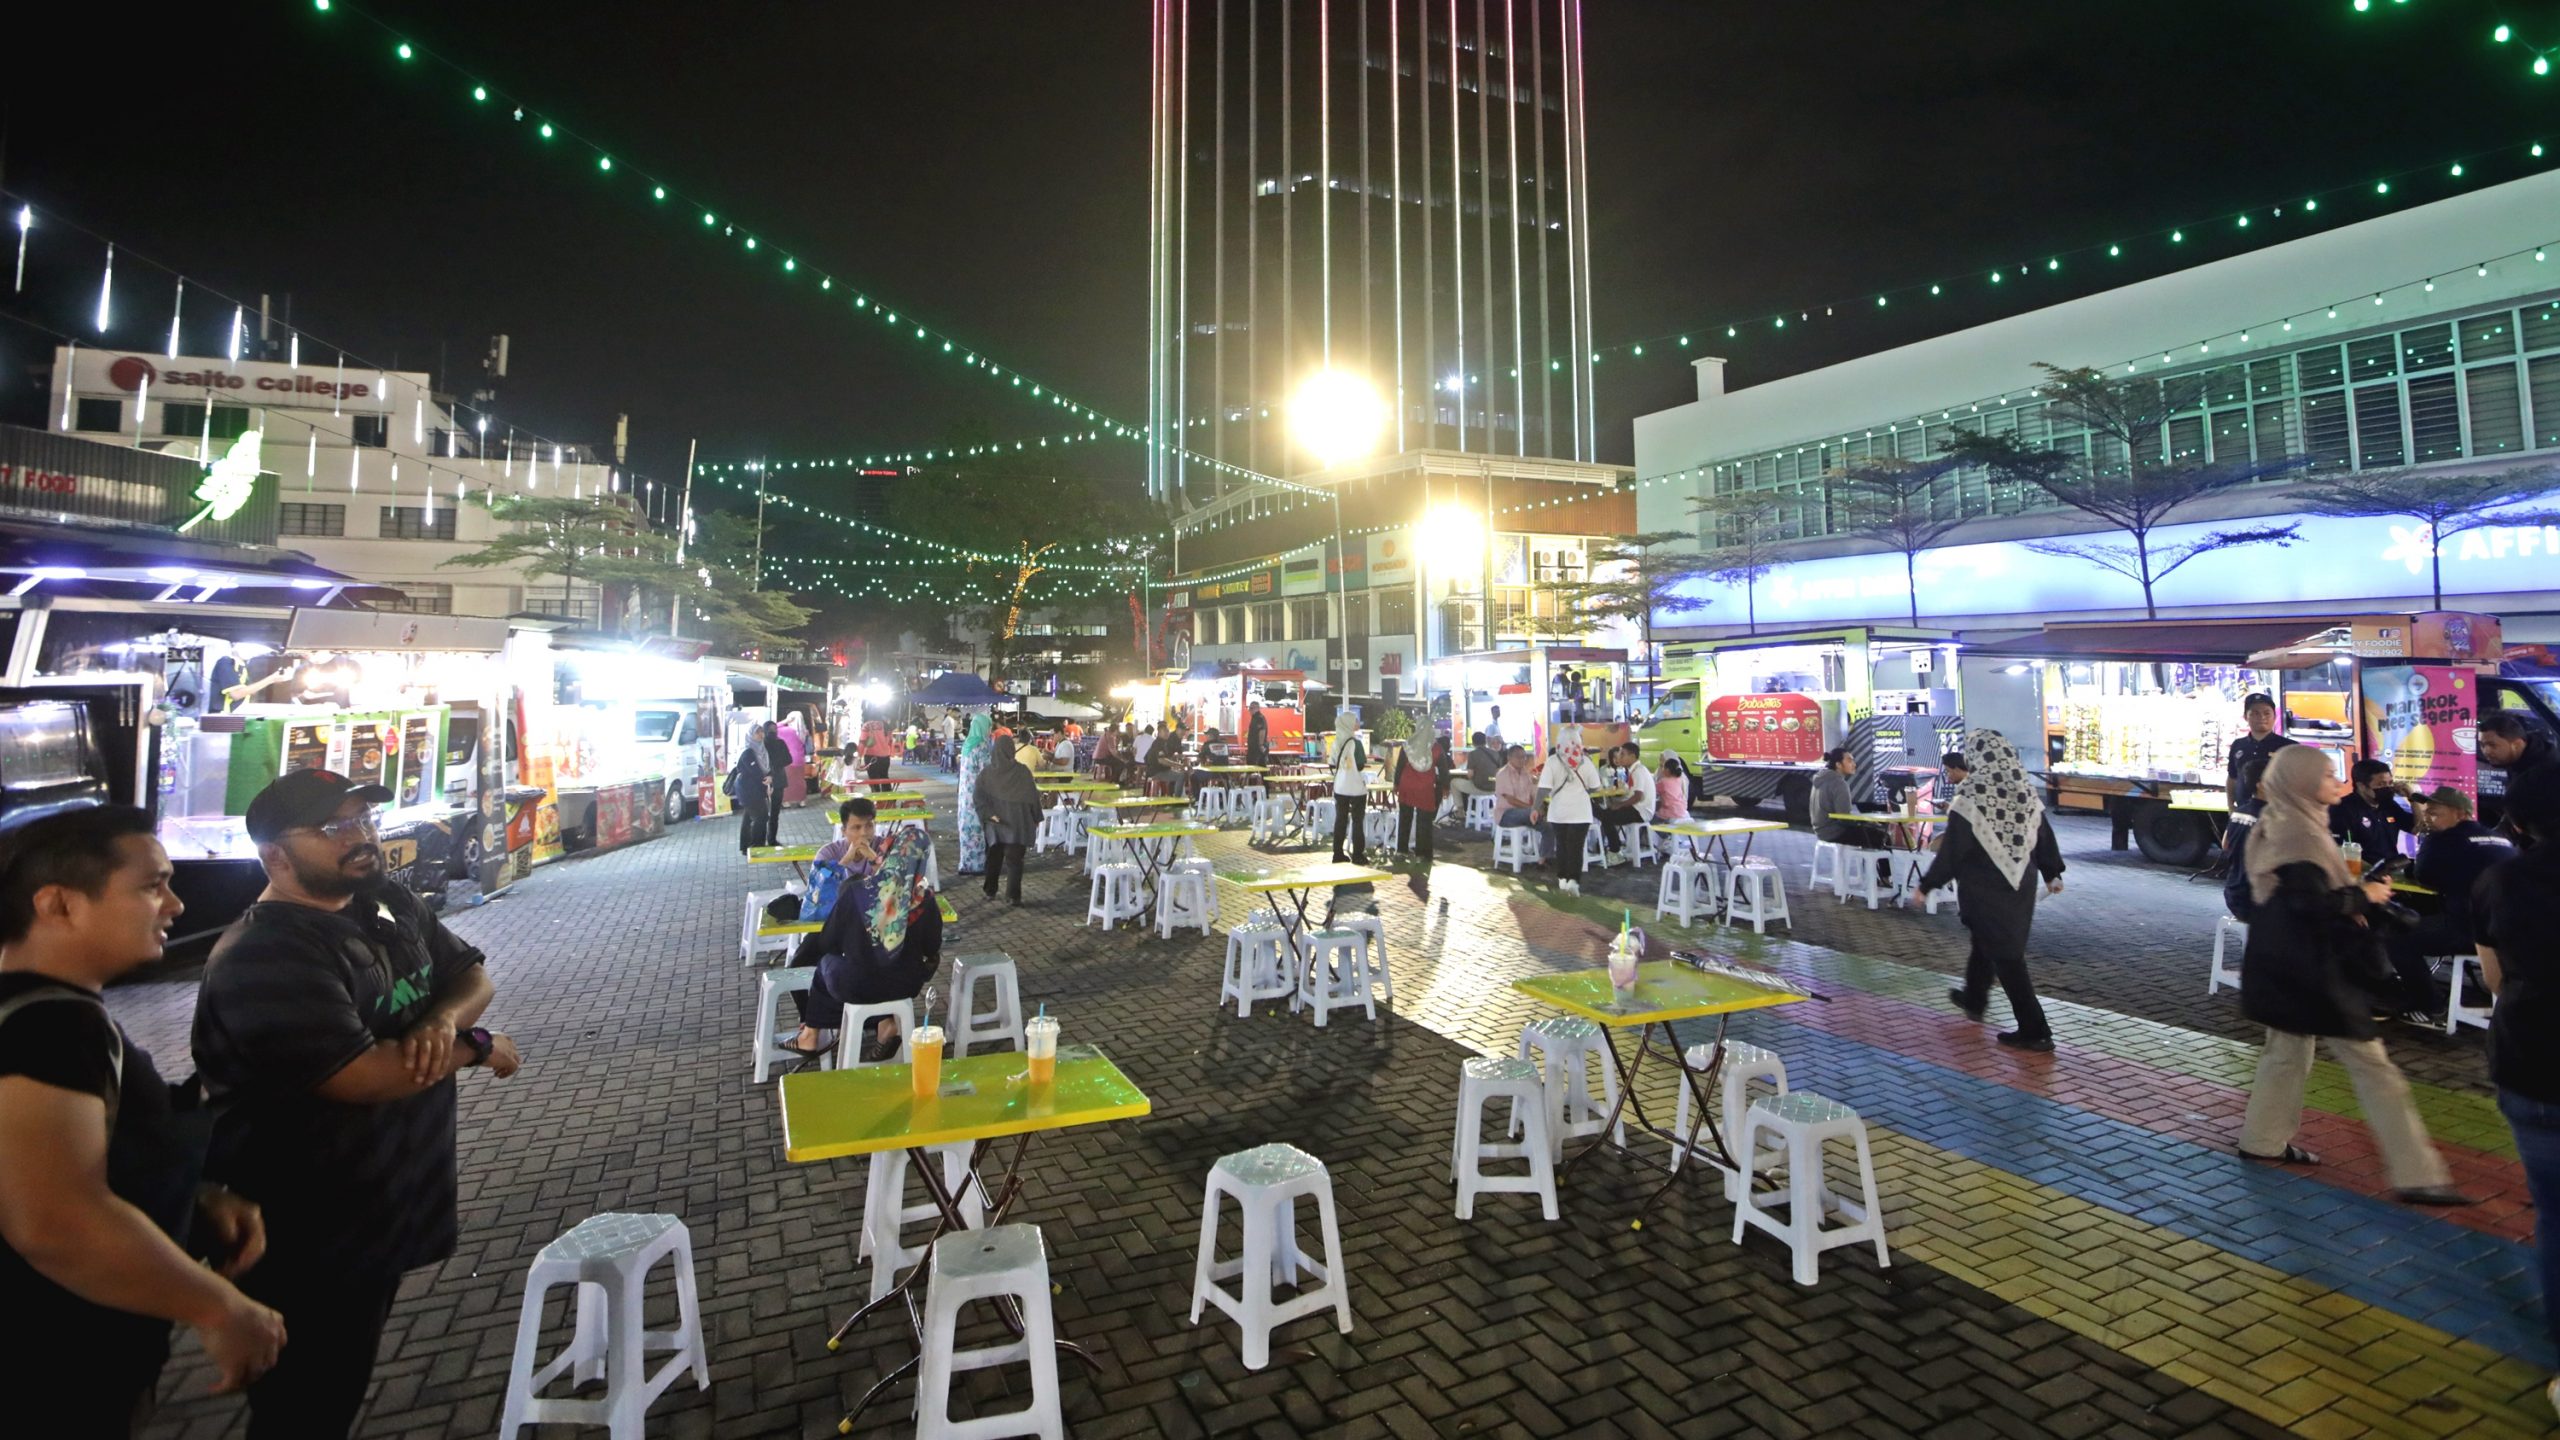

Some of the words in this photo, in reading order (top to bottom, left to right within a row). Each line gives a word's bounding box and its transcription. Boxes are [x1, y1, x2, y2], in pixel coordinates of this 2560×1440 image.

[163, 369, 245, 390] saito
[256, 375, 370, 400] college
[24, 469, 77, 495] FOOD
[2365, 639, 2402, 648] FOODIE
